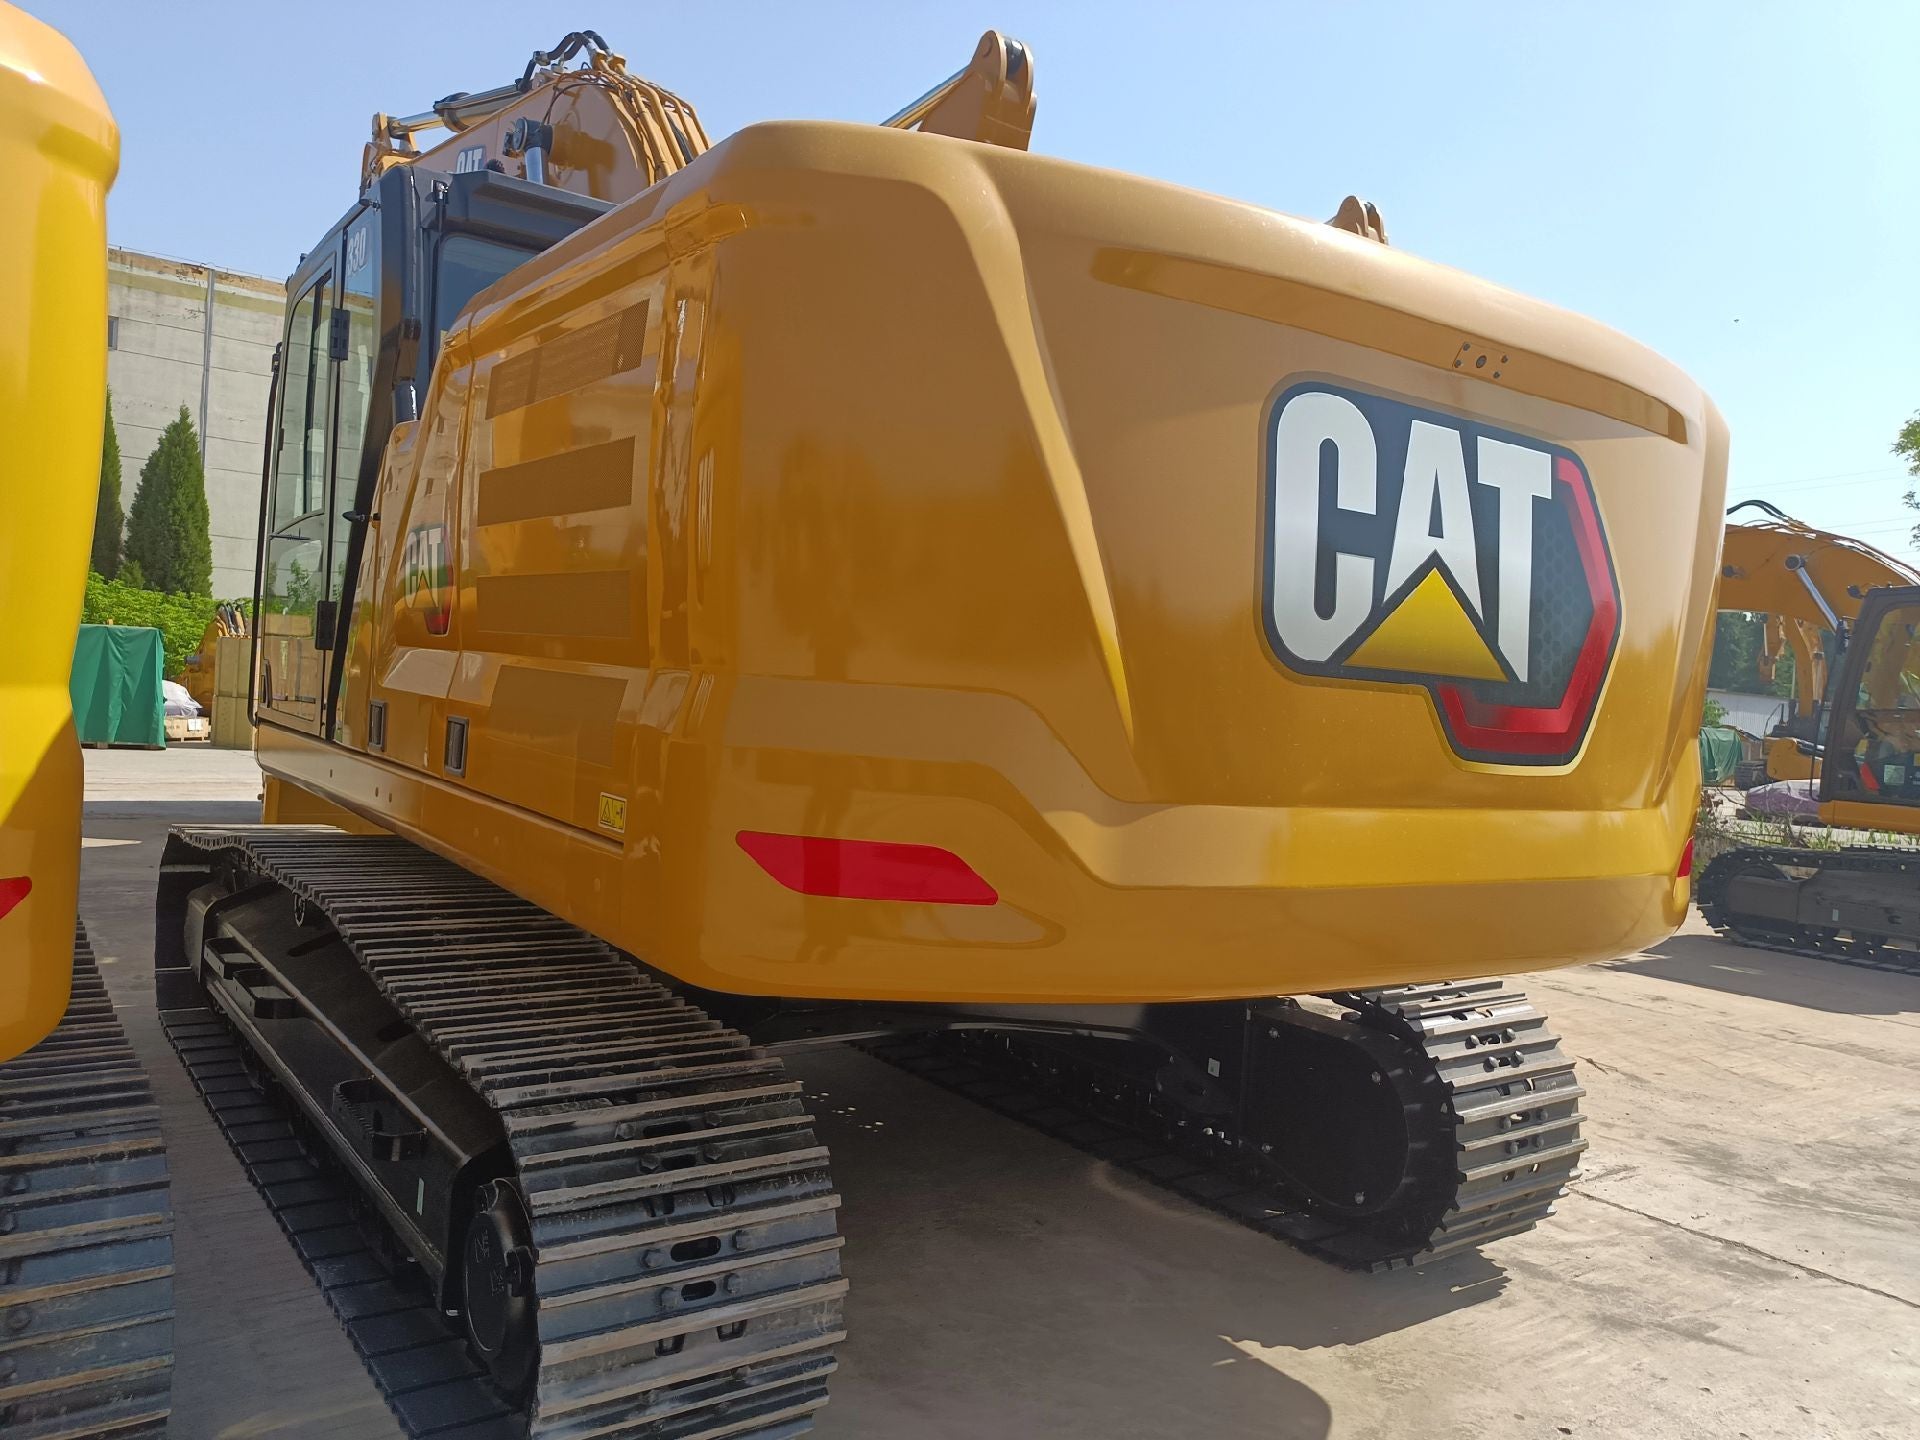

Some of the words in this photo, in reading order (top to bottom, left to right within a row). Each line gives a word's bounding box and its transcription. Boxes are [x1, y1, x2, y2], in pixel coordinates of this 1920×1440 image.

[347, 227, 367, 277] 330
[405, 527, 442, 608] CAT
[1273, 391, 1552, 683] CAT
